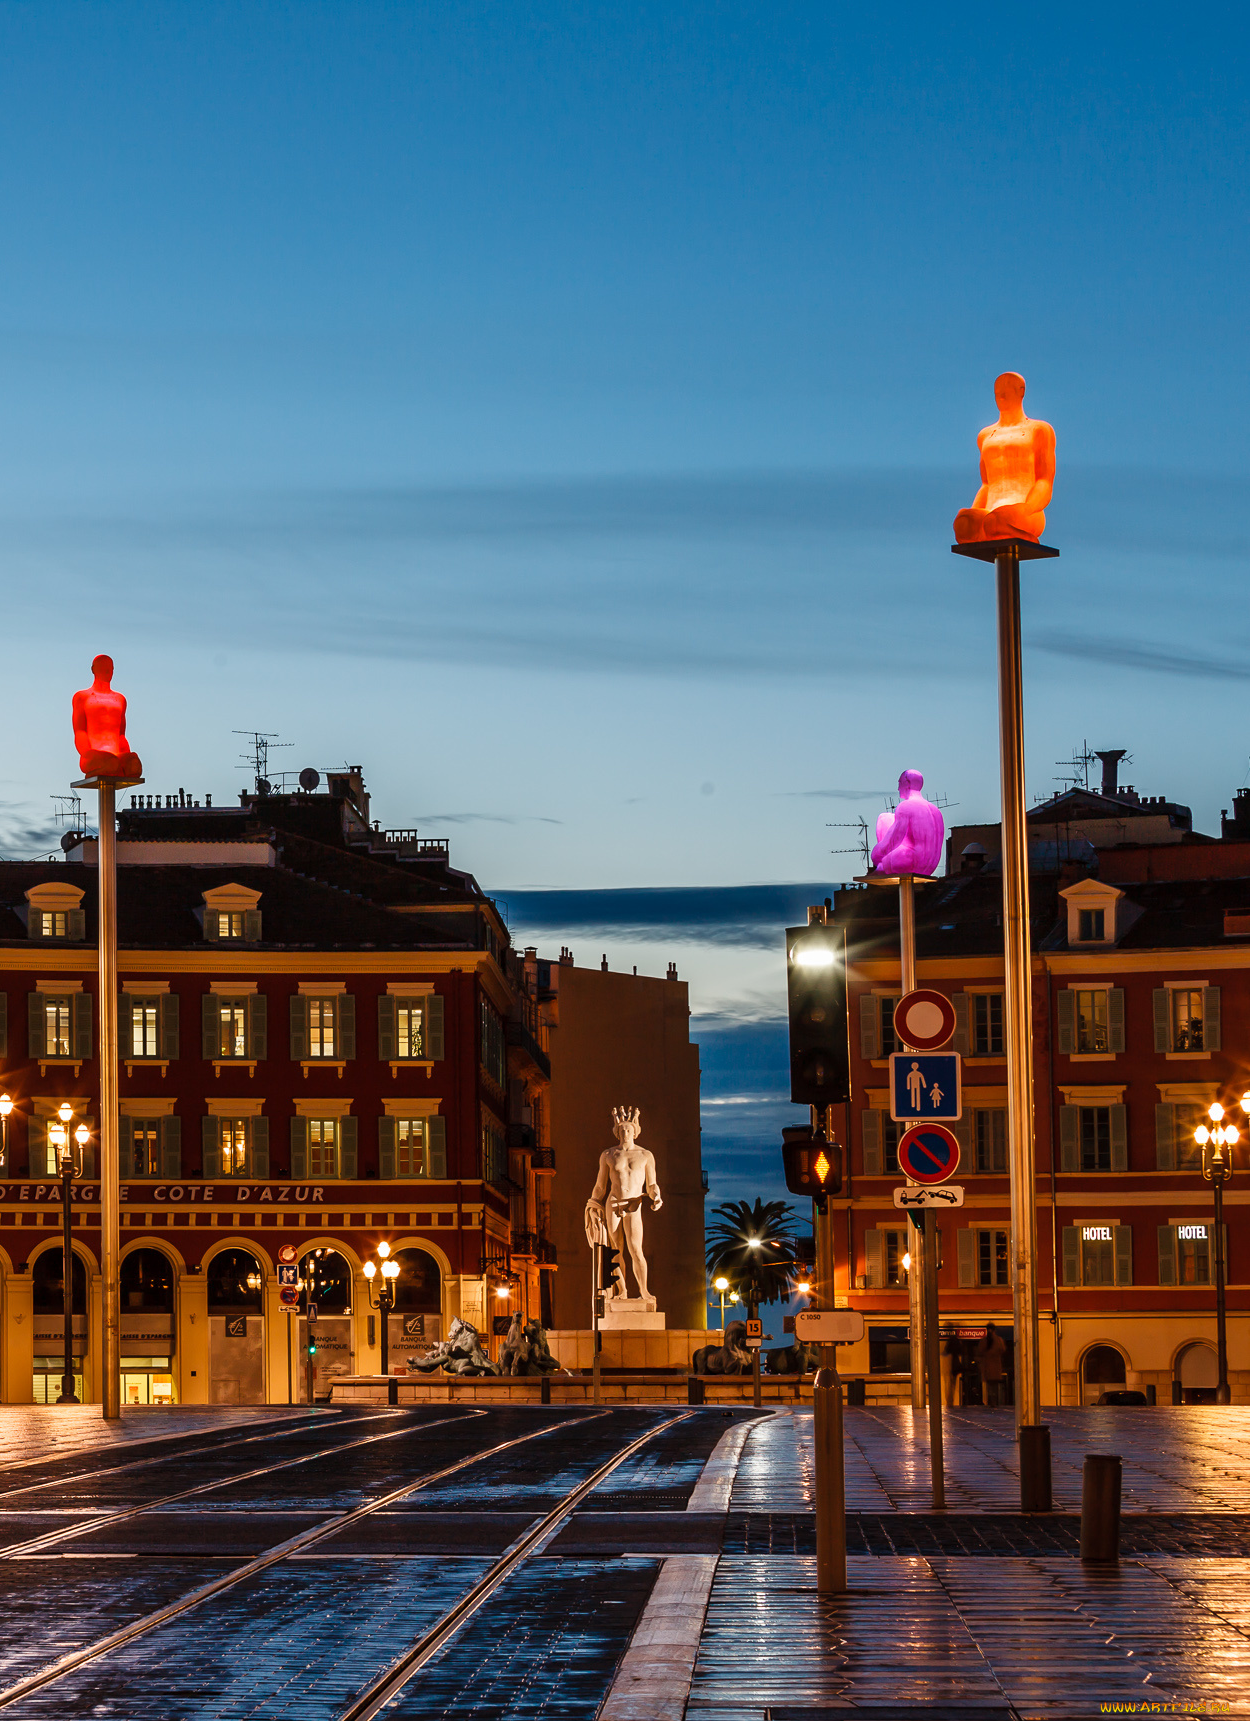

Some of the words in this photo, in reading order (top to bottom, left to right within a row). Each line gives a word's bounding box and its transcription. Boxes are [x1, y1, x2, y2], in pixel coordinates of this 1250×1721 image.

[153, 1186, 214, 1201] COTE
[237, 1186, 324, 1202] D'AZUR
[1082, 1227, 1113, 1241] HOTEL
[1178, 1225, 1208, 1240] HOTEL
[749, 1324, 759, 1332] 15
